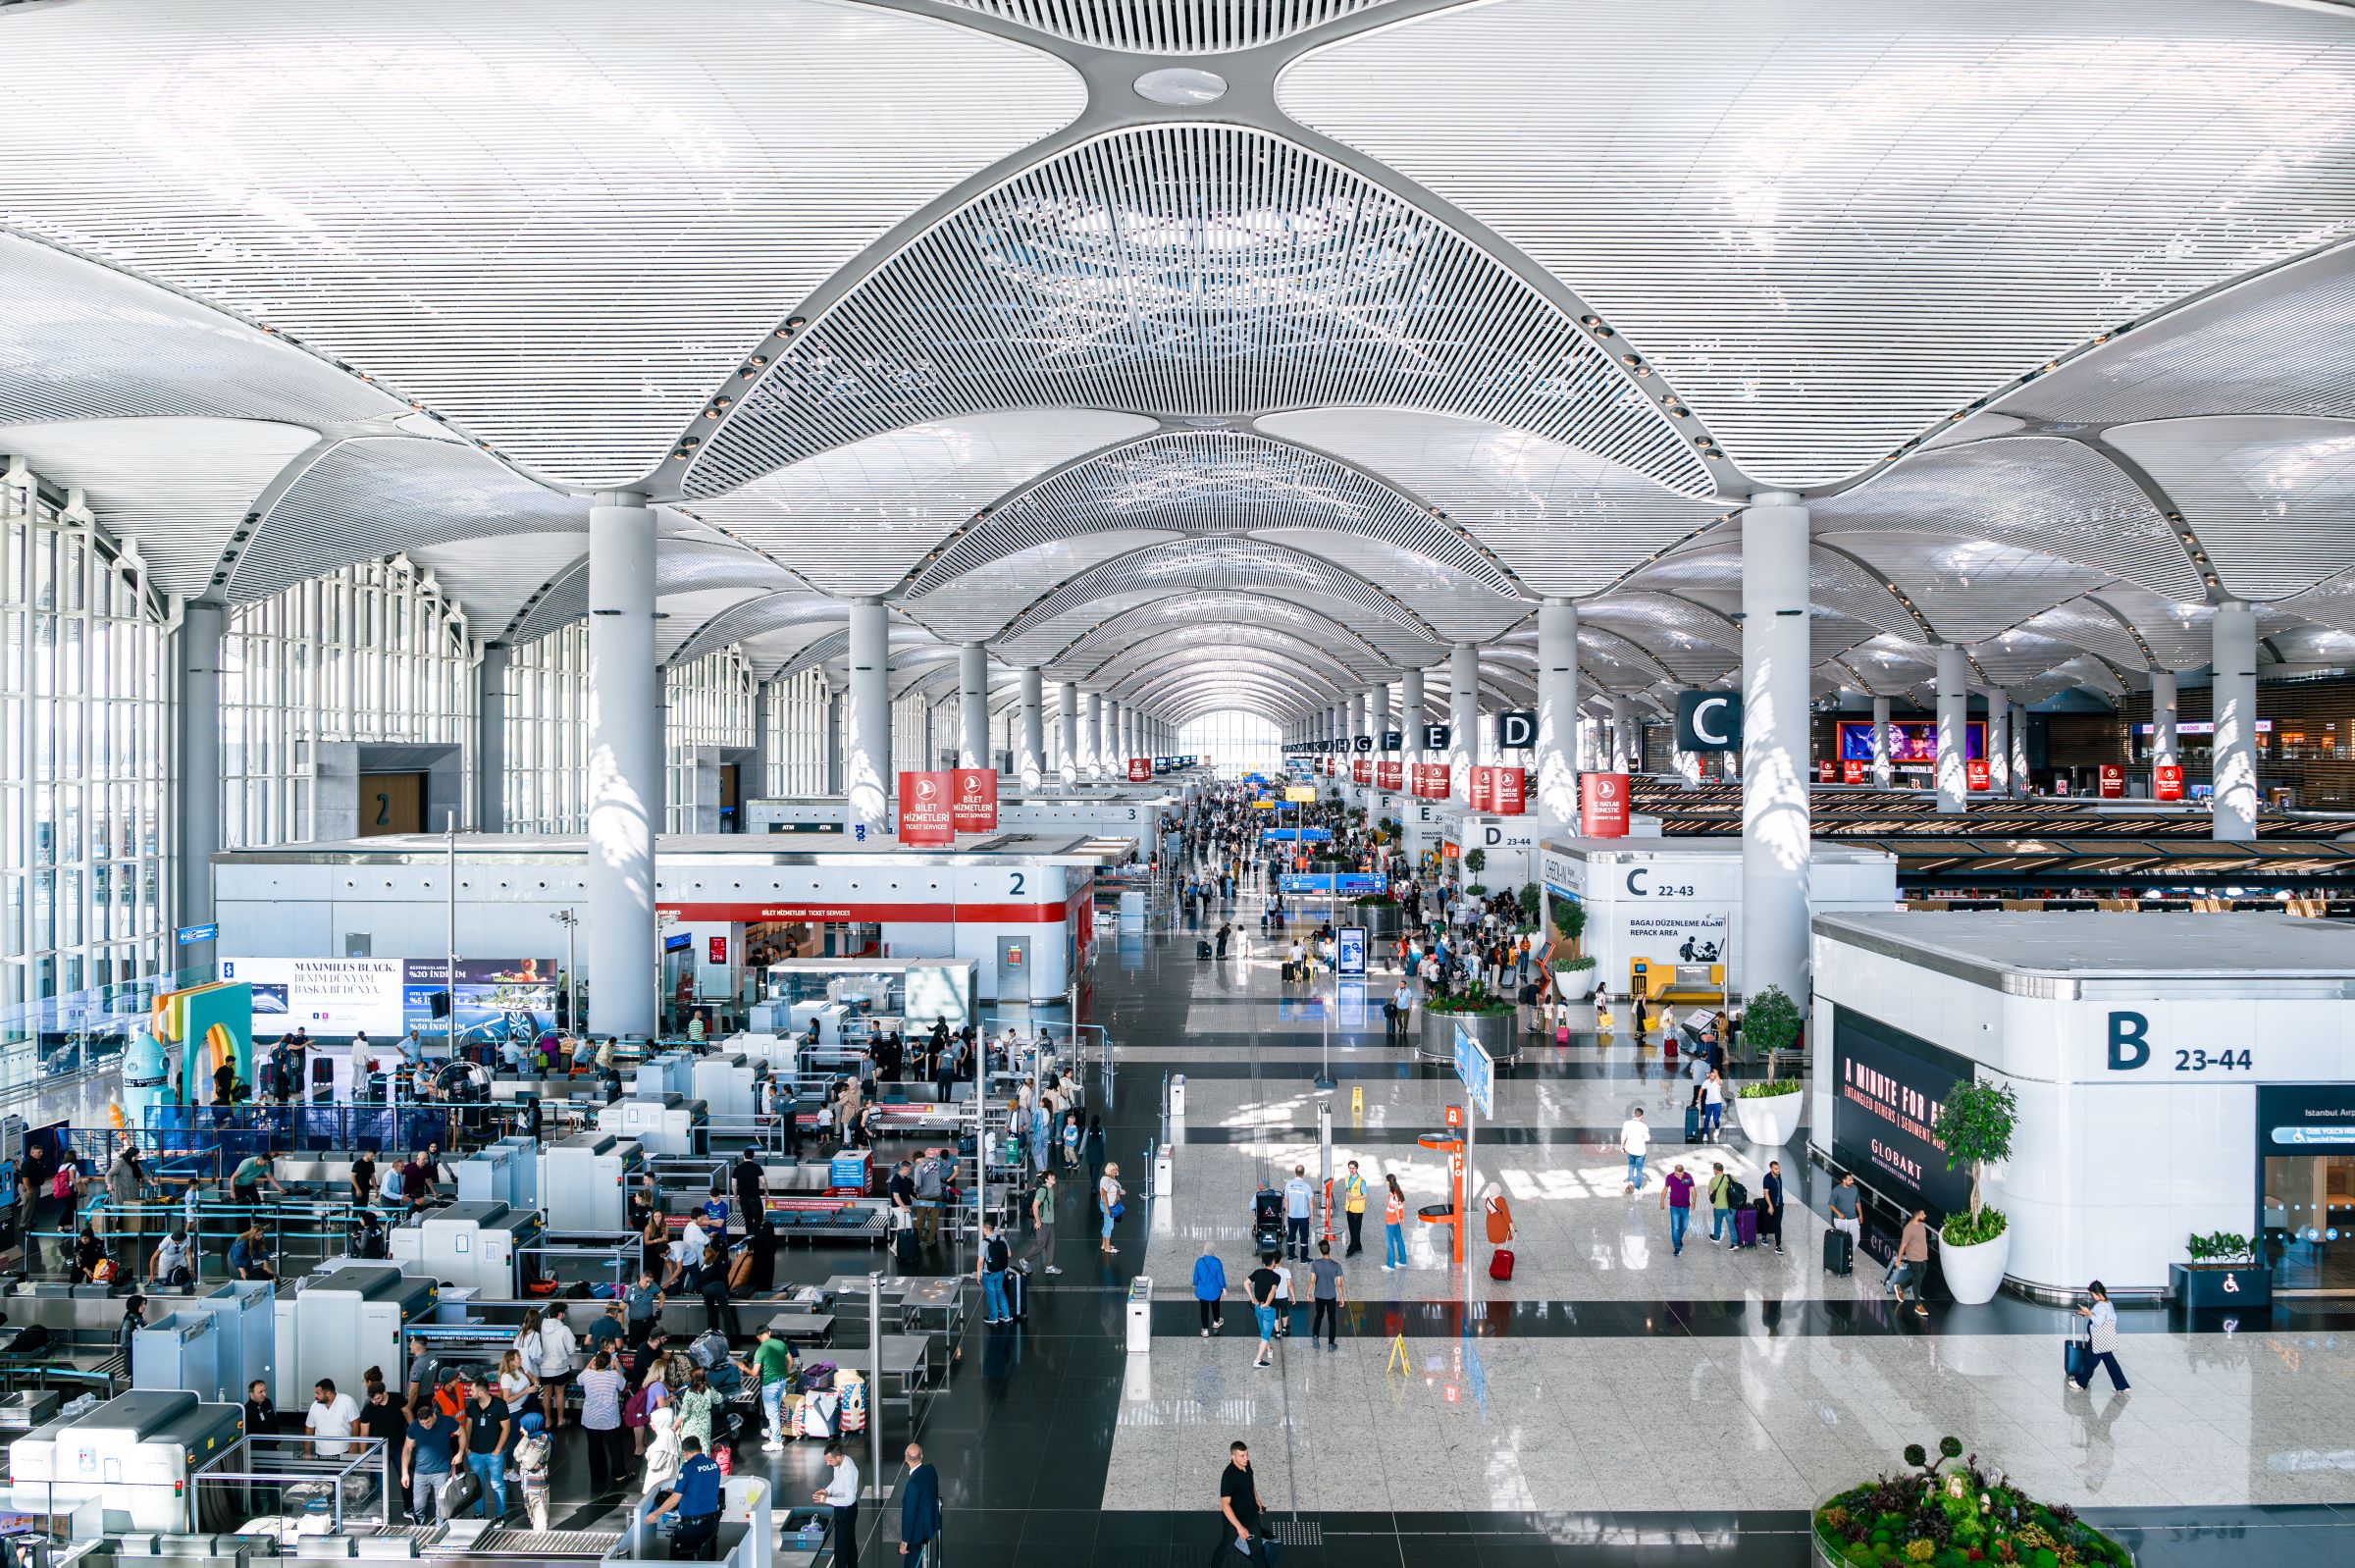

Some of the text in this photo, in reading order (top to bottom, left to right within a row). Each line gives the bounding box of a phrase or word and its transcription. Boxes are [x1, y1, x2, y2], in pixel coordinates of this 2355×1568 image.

[1693, 698, 1728, 744] C
[1430, 727, 1442, 748] E
[1506, 716, 1530, 745] D
[1314, 743, 1320, 752] K
[1326, 742, 1331, 752] J
[1338, 740, 1346, 751] H
[1356, 738, 1368, 751] G
[1386, 734, 1395, 749] F
[377, 793, 390, 825] 2
[916, 803, 937, 812] BİLET
[1383, 797, 1389, 807] F
[903, 811, 950, 821] HİZMETLERİ
[1128, 809, 1136, 819] 3
[1422, 807, 1430, 820] E
[1486, 827, 1501, 845] D
[1009, 872, 1024, 895] 2
[1627, 868, 1694, 896] C 22-43
[295, 973, 374, 982] BENİM DÜNYAM
[295, 985, 327, 995] BAŞKA
[2108, 1011, 2252, 1071] B 23-44
[1845, 1058, 1852, 1082] A
[1857, 1063, 1897, 1107] MINUTE
[1903, 1084, 1924, 1122] FOR
[1845, 1084, 1873, 1111] ENTANGLED
[1874, 1100, 1896, 1124] OTHERS
[1902, 1116, 1930, 1143] SEDIMENT
[1871, 1138, 1922, 1180] GLOBART
[697, 1462, 718, 1472] POLİS
